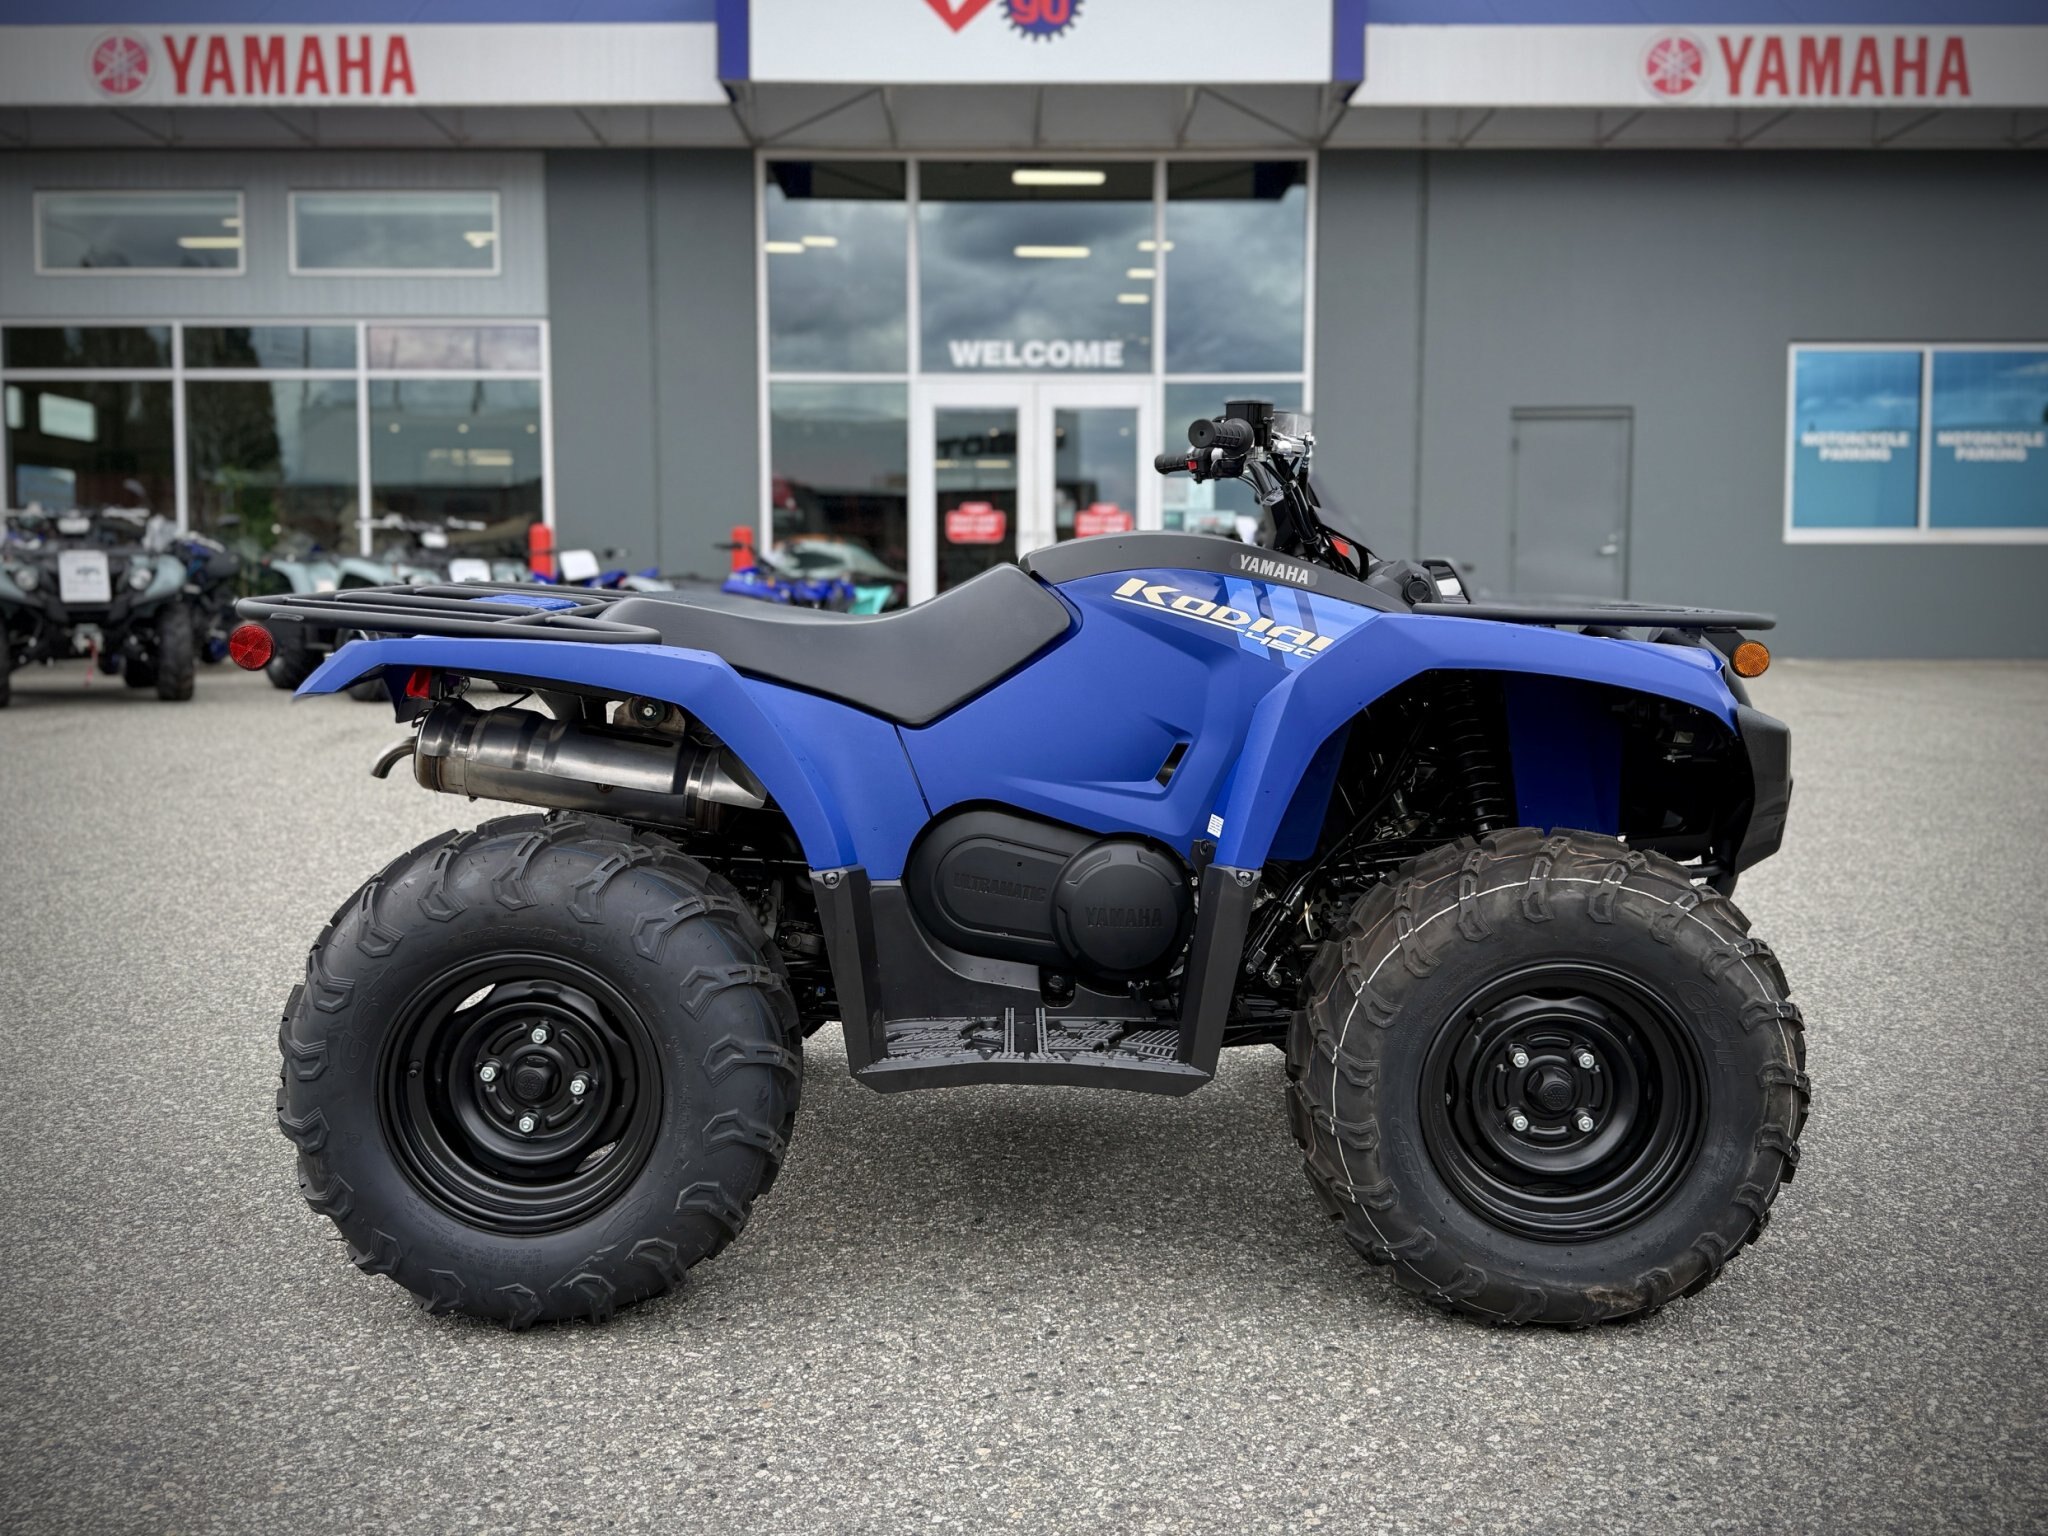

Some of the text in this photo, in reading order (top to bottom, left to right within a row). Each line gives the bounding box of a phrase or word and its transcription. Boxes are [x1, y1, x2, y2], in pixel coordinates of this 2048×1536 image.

[162, 34, 416, 96] YAMAHA
[1717, 36, 1972, 97] YAMAHA
[949, 340, 1124, 368] WELCOME
[1801, 431, 1909, 447] MOTORCYCLE
[1937, 431, 2045, 447] MOTORCYCLE
[1819, 447, 1892, 462] PARKING
[1955, 447, 2027, 462] PARKING
[1240, 554, 1309, 585] YAMAHA
[953, 872, 1047, 903] ULTRAMATIC
[1085, 905, 1162, 928] YAMAHA
